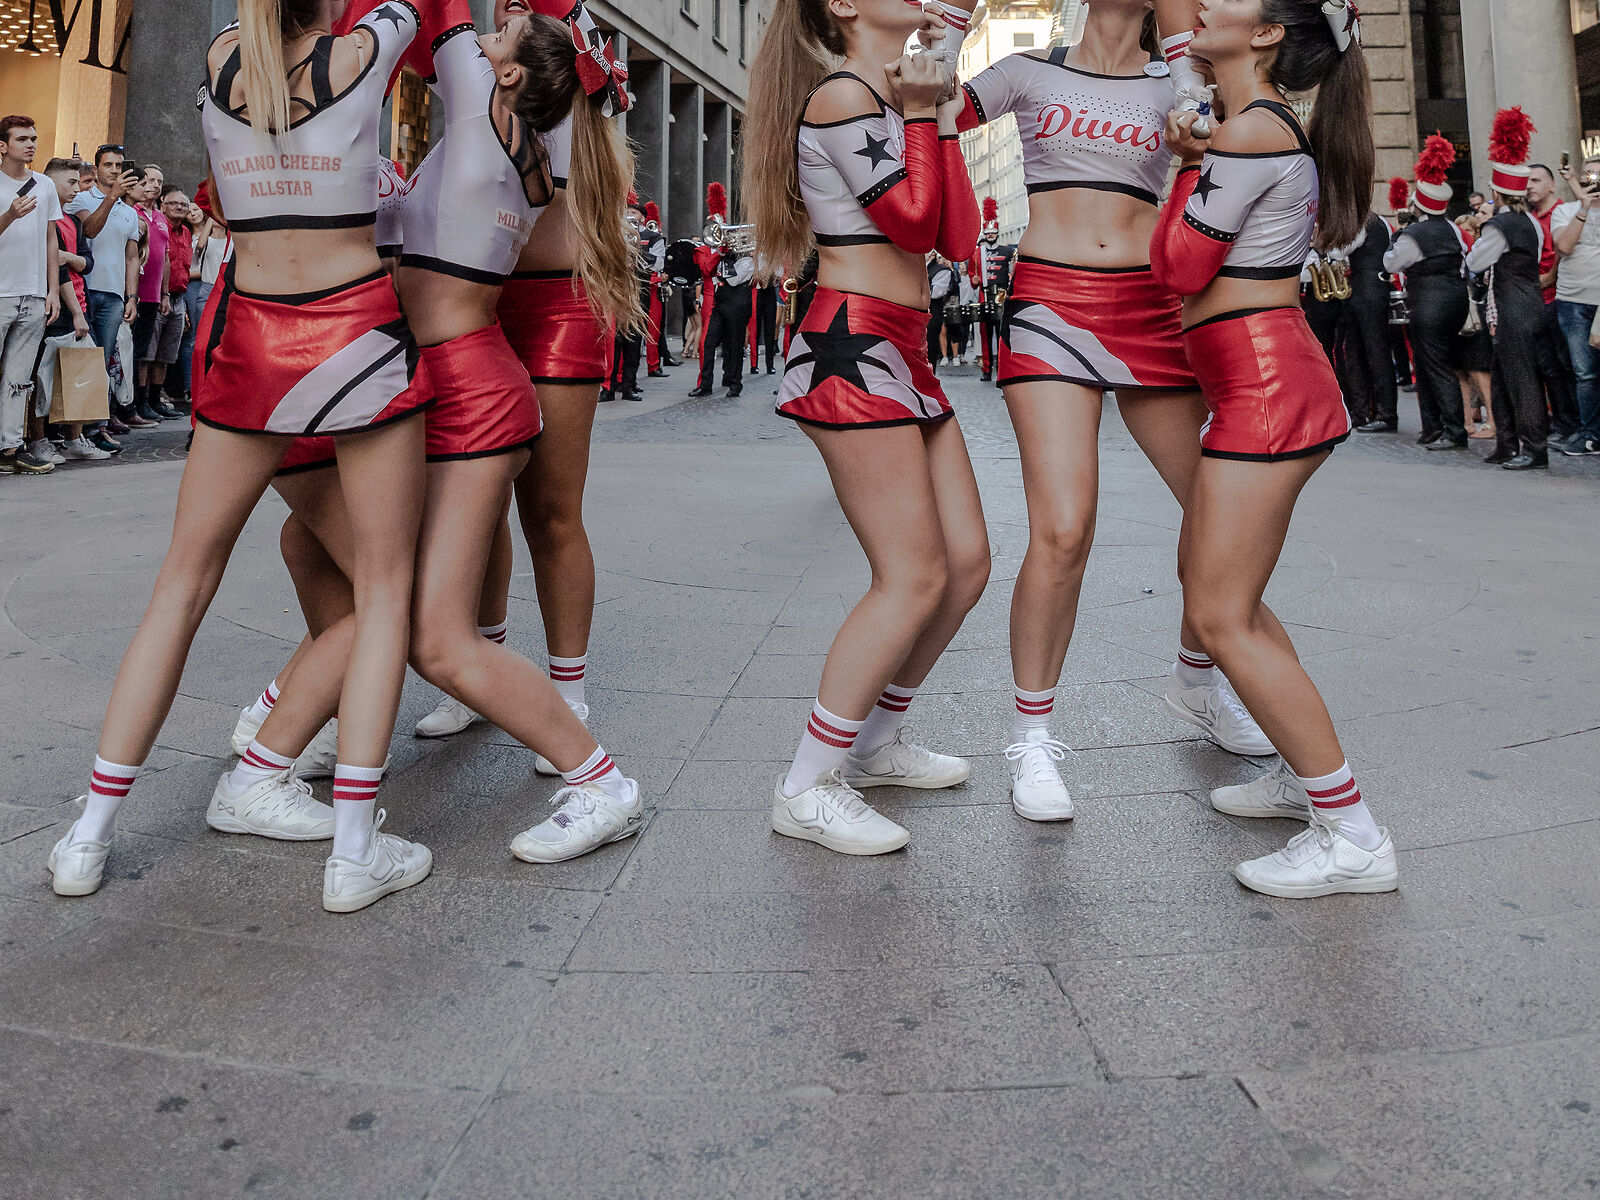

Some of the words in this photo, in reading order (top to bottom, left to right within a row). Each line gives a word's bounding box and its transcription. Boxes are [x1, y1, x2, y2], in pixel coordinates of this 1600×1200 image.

[1035, 103, 1160, 152] Divas
[221, 154, 275, 177] MILANO
[280, 153, 342, 172] CHEERS
[250, 181, 313, 198] ALLSTAR
